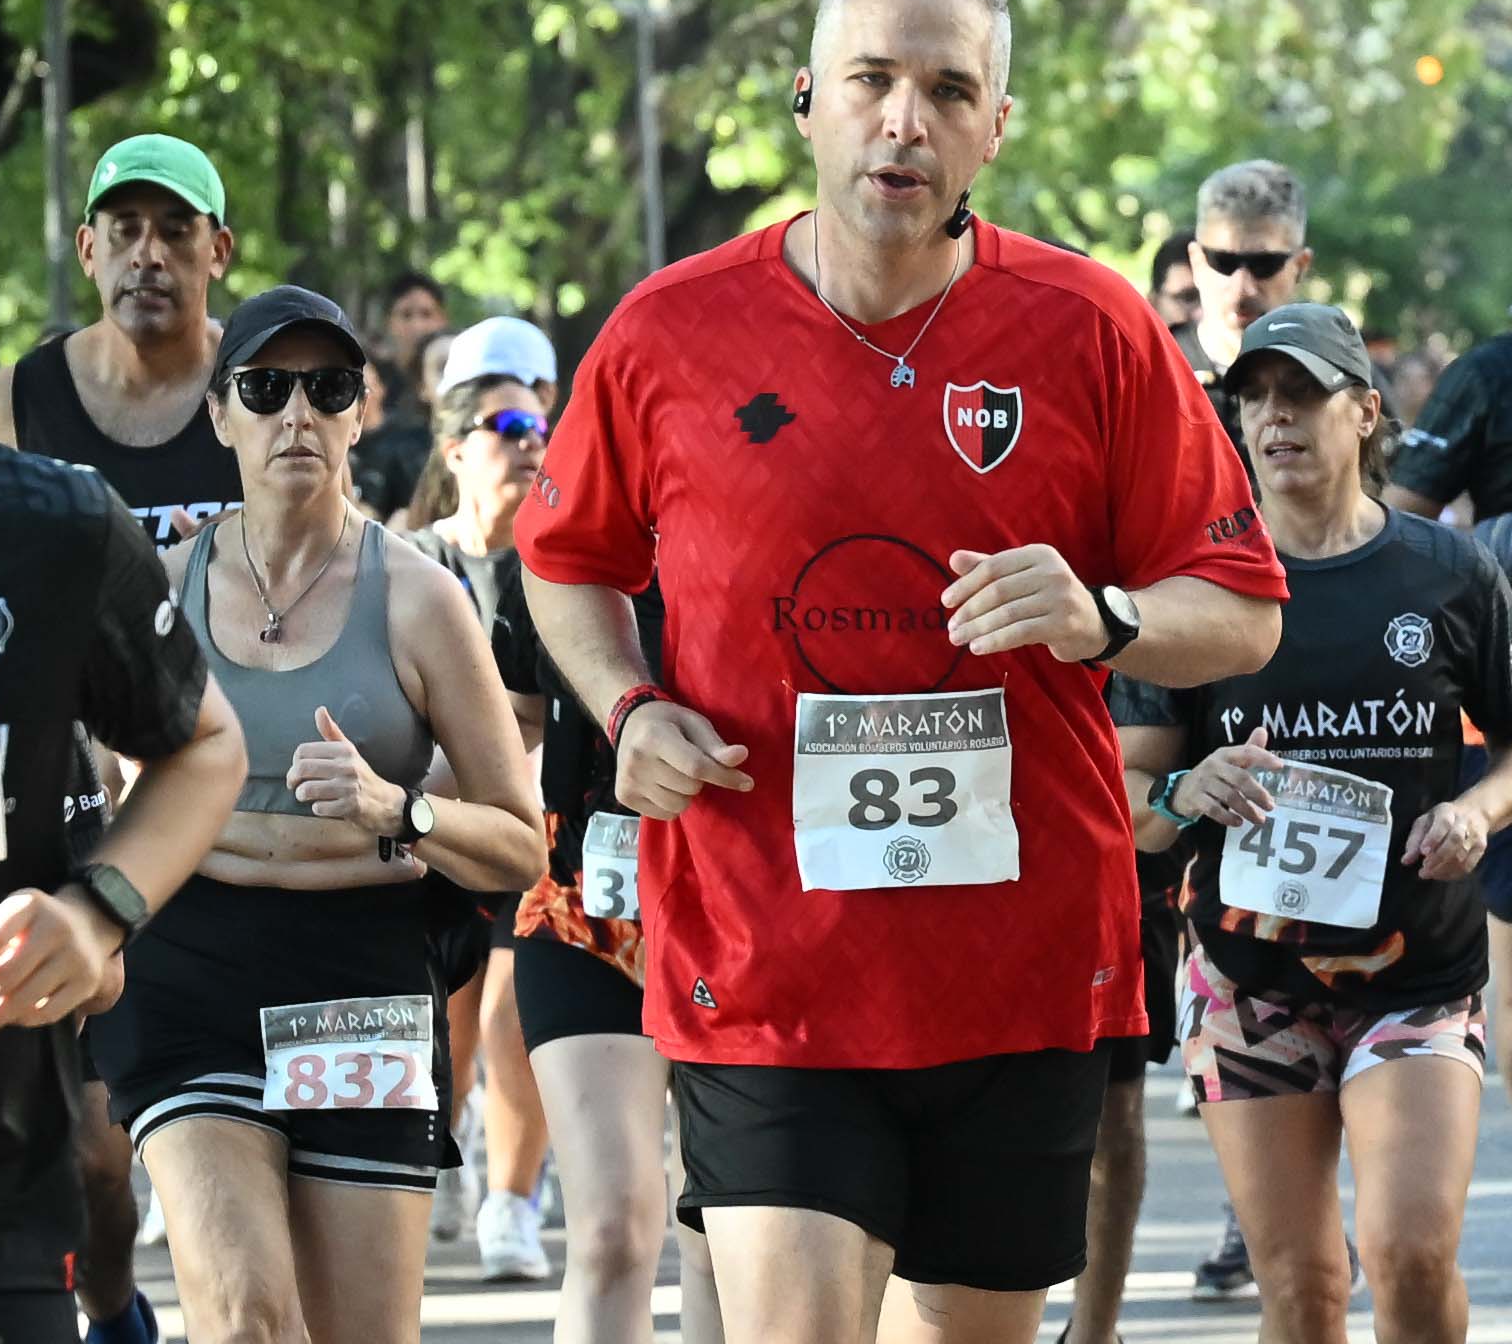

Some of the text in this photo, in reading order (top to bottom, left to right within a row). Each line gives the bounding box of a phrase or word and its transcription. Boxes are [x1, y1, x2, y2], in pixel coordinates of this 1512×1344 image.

[957, 407, 1008, 429] NOB
[1402, 629, 1422, 647] 27
[825, 703, 983, 738] 1º MARATÓN
[1220, 688, 1436, 744] 1º MARATÓN
[909, 739, 969, 752] VOLUNTARIOS
[969, 735, 1005, 749] ROSARIO
[1328, 746, 1402, 760] VOLUNTARIOS
[848, 766, 958, 831] 83
[1277, 782, 1371, 808] MARATÓN
[897, 850, 917, 867] 27
[1239, 816, 1366, 880] 457
[289, 1002, 415, 1038] 1º MARATÓN
[284, 1052, 421, 1108] 832
